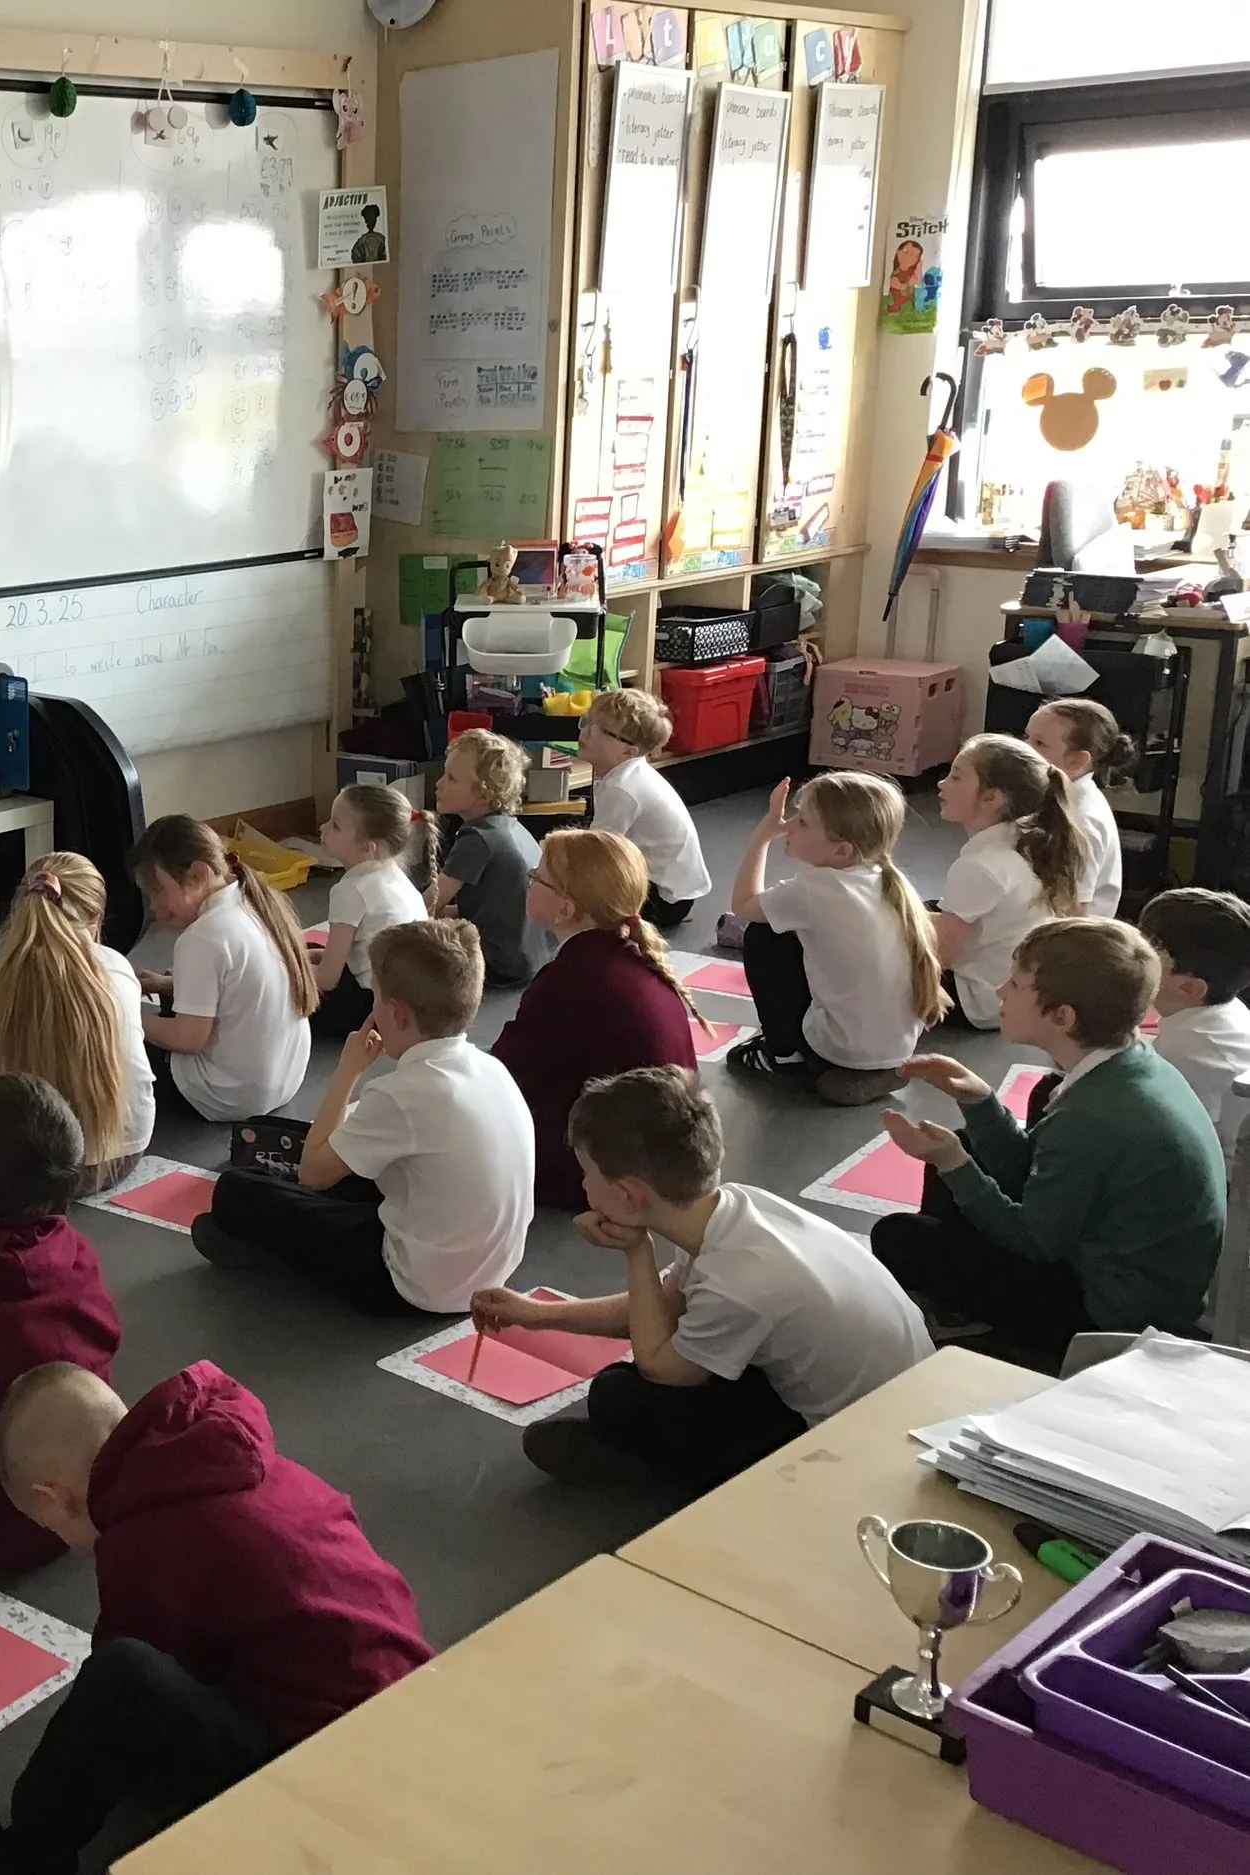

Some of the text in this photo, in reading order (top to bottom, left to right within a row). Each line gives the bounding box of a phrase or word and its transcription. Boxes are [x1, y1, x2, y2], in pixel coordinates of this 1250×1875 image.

[451, 224, 511, 243] Group Points
[136, 582, 204, 615] Character
[64, 652, 77, 675] to
[90, 644, 122, 673] write
[134, 638, 164, 667] about
